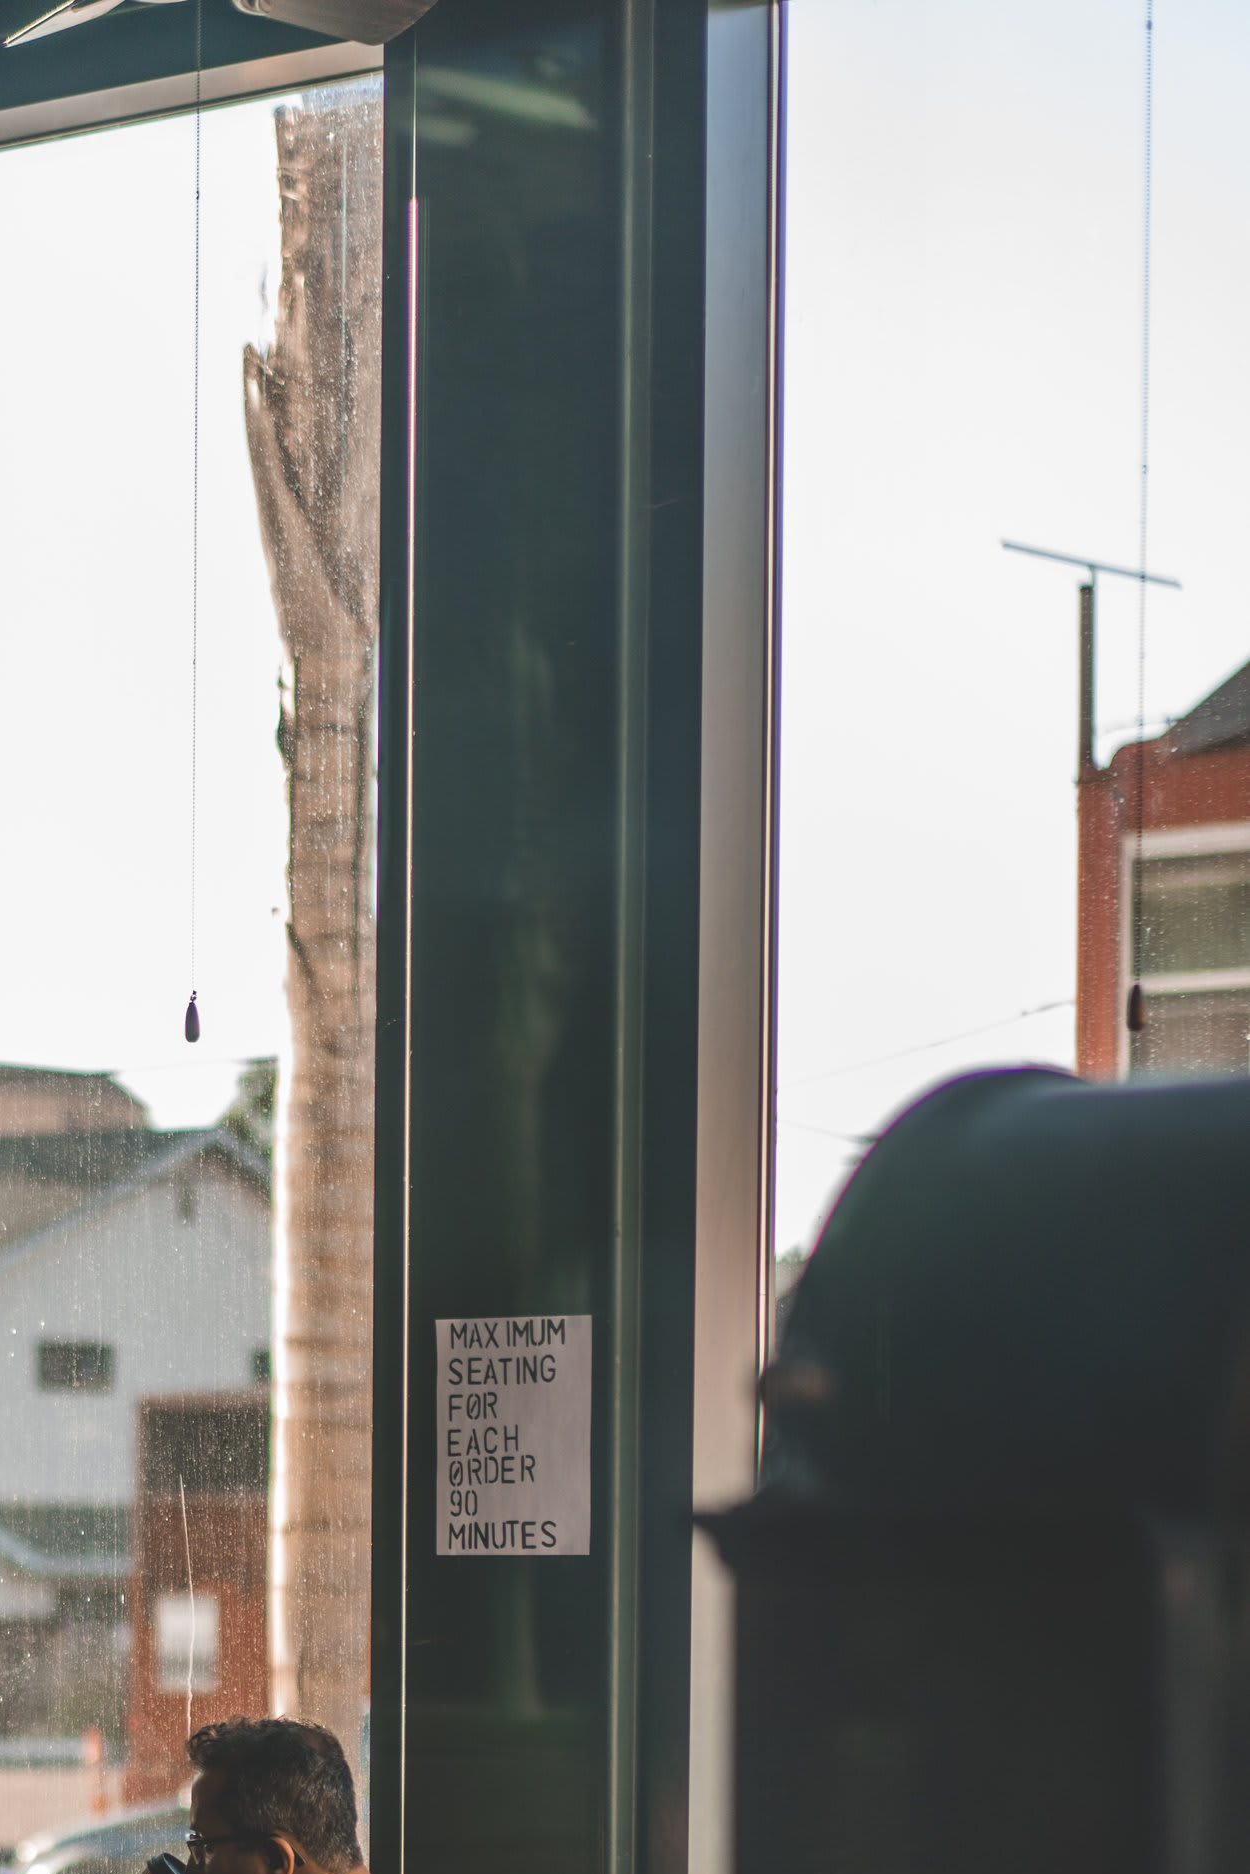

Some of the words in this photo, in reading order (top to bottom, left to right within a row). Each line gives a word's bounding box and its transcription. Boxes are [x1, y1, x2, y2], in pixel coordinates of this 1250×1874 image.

[450, 1318, 566, 1349] MAXIMUM
[448, 1354, 557, 1385] SEATING
[447, 1424, 519, 1457] EACH
[450, 1489, 478, 1517] 90
[448, 1520, 557, 1550] MINUTES
